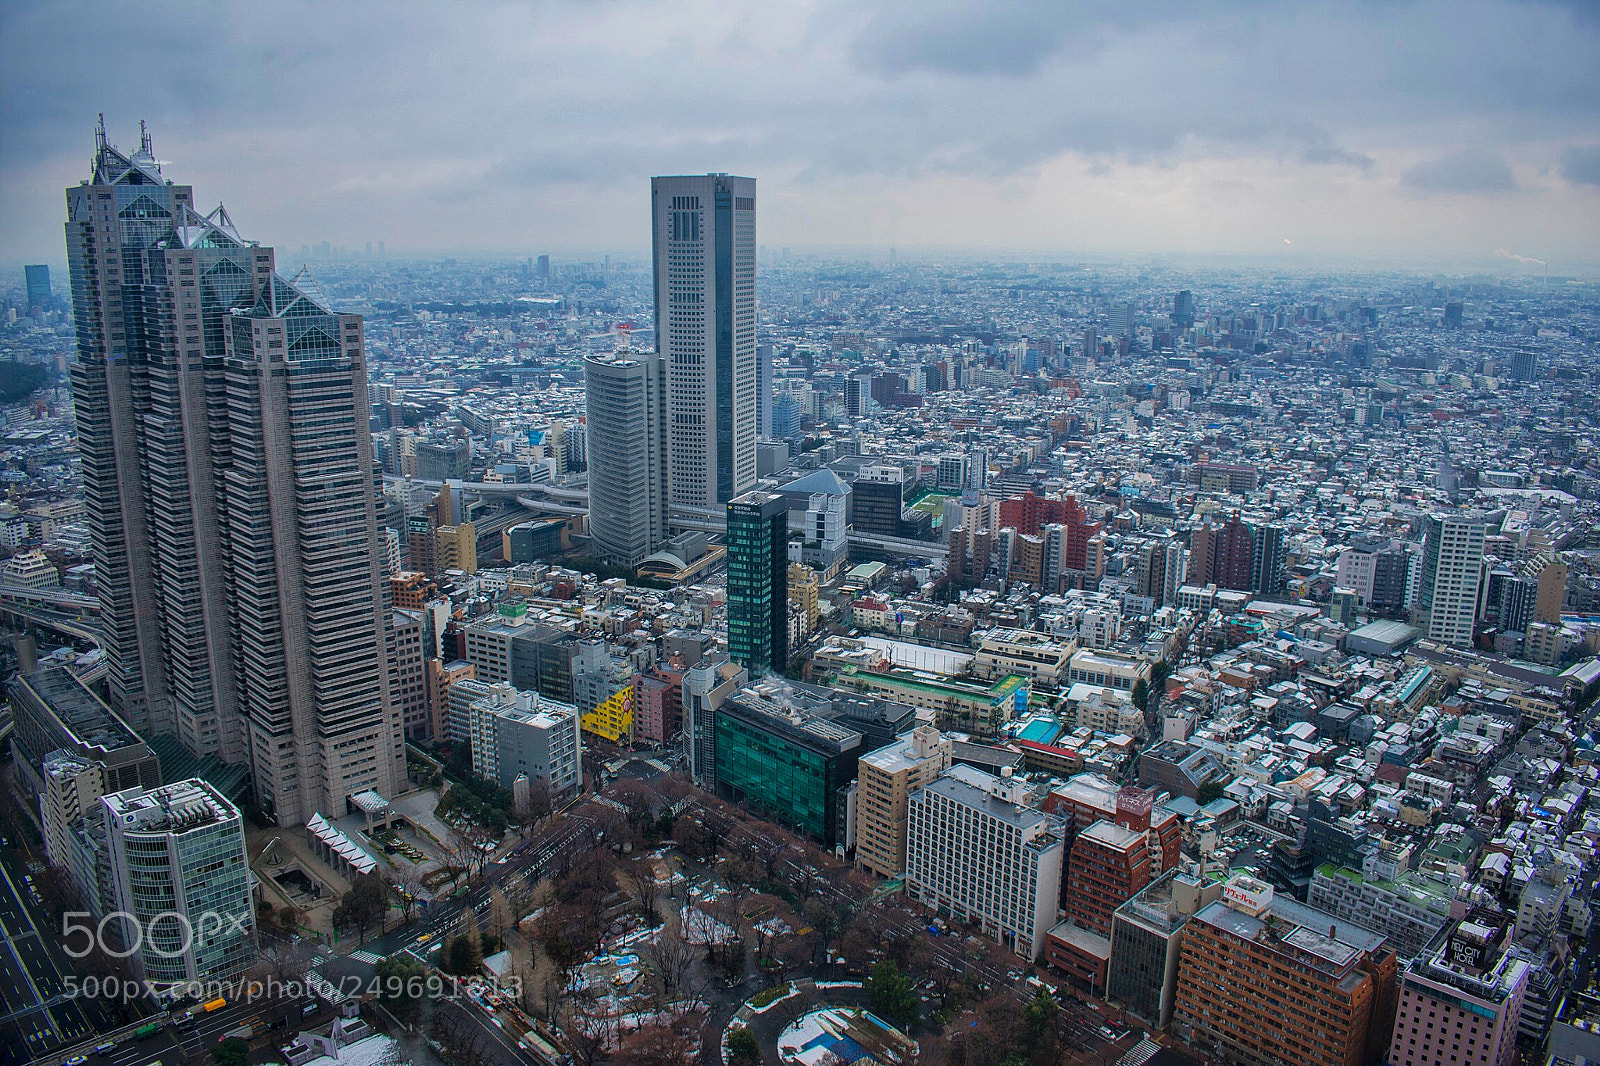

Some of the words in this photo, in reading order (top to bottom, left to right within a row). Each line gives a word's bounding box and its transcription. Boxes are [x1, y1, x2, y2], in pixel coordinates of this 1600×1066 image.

[1451, 941, 1465, 953] NEW
[1464, 946, 1481, 959] CITY
[1453, 951, 1475, 967] HOTEL
